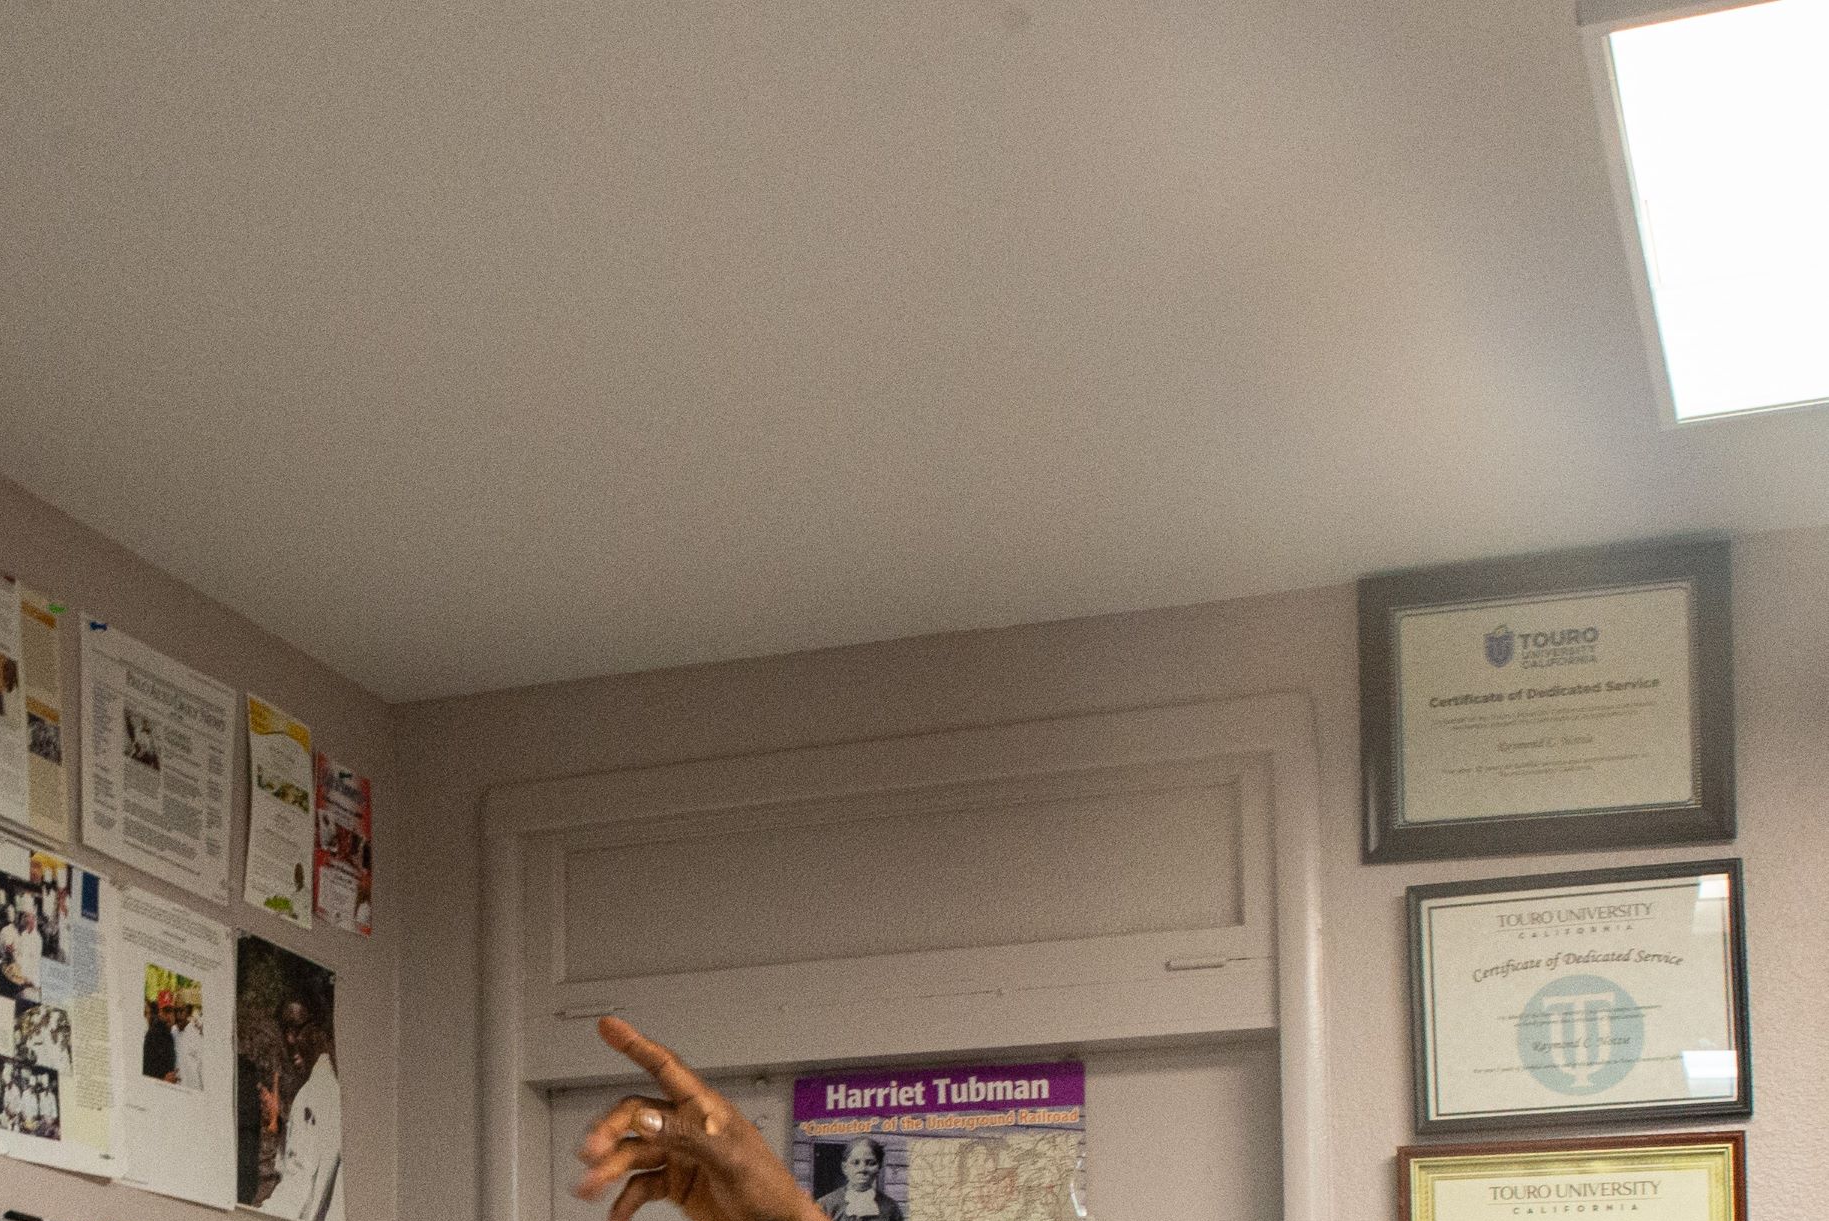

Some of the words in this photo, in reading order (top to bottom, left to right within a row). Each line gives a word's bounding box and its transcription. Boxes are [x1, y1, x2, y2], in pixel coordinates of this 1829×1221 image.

[1519, 626, 1599, 648] TOURO
[1429, 689, 1503, 708] Certificate
[1507, 688, 1524, 701] of
[1526, 682, 1601, 699] Dedicated
[1606, 676, 1660, 692] Service
[1497, 911, 1553, 929] TOURO
[1557, 902, 1653, 924] UNIVERSITY
[1472, 957, 1542, 983] Certificate
[1546, 954, 1560, 971] of
[1564, 948, 1632, 968] Dedicated
[1634, 950, 1684, 968] Service
[826, 1082, 926, 1111] Harriet
[932, 1076, 1049, 1106] Tubman
[883, 1116, 898, 1132] of
[901, 1114, 923, 1131] the
[925, 1111, 1016, 1132] Underground
[1019, 1107, 1081, 1126] Railroad
[1489, 1184, 1552, 1202] TOURO
[1556, 1179, 1661, 1199] UNIVERSITY
[1513, 1204, 1640, 1216] CALIFORNIA
